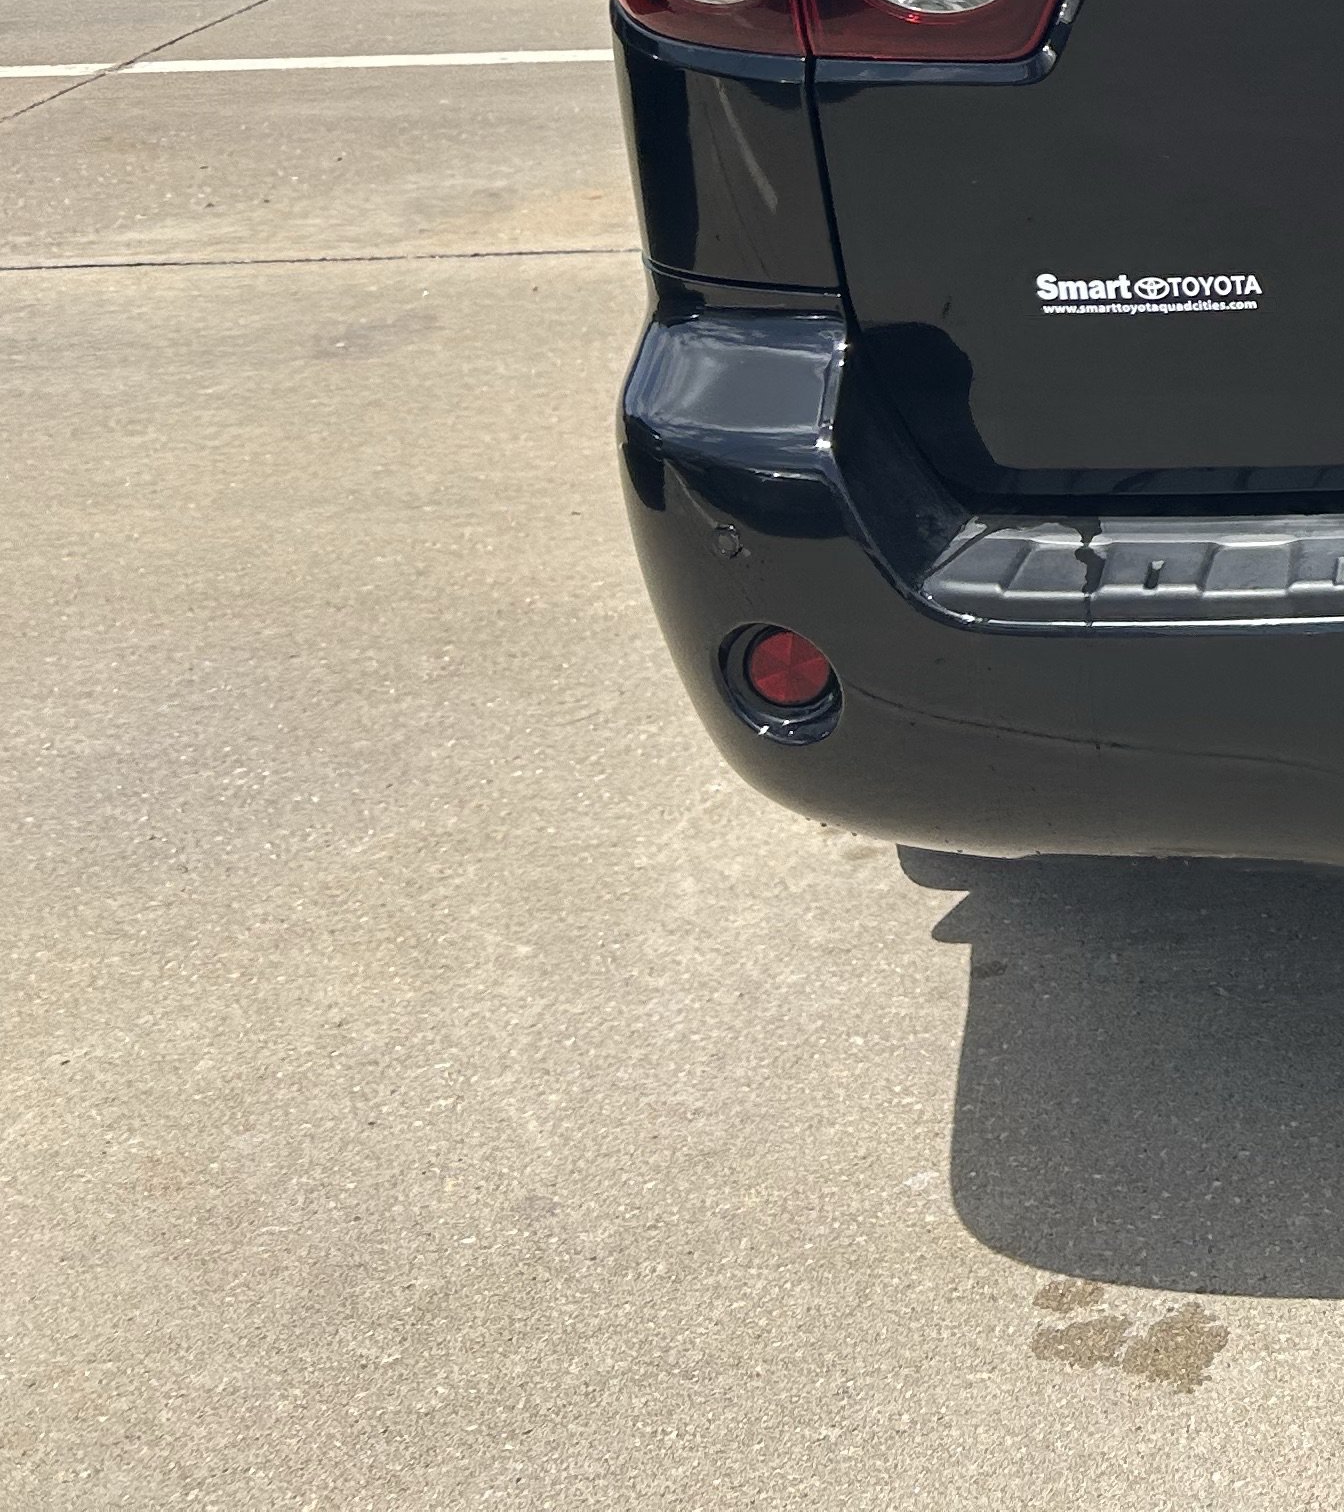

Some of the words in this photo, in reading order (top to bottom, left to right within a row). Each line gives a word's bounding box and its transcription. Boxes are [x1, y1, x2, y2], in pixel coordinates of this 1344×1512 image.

[1036, 273, 1132, 299] Smart
[1167, 275, 1262, 296] TOYOTA
[1043, 299, 1257, 315] www.smarttoyotaquadcities.com
